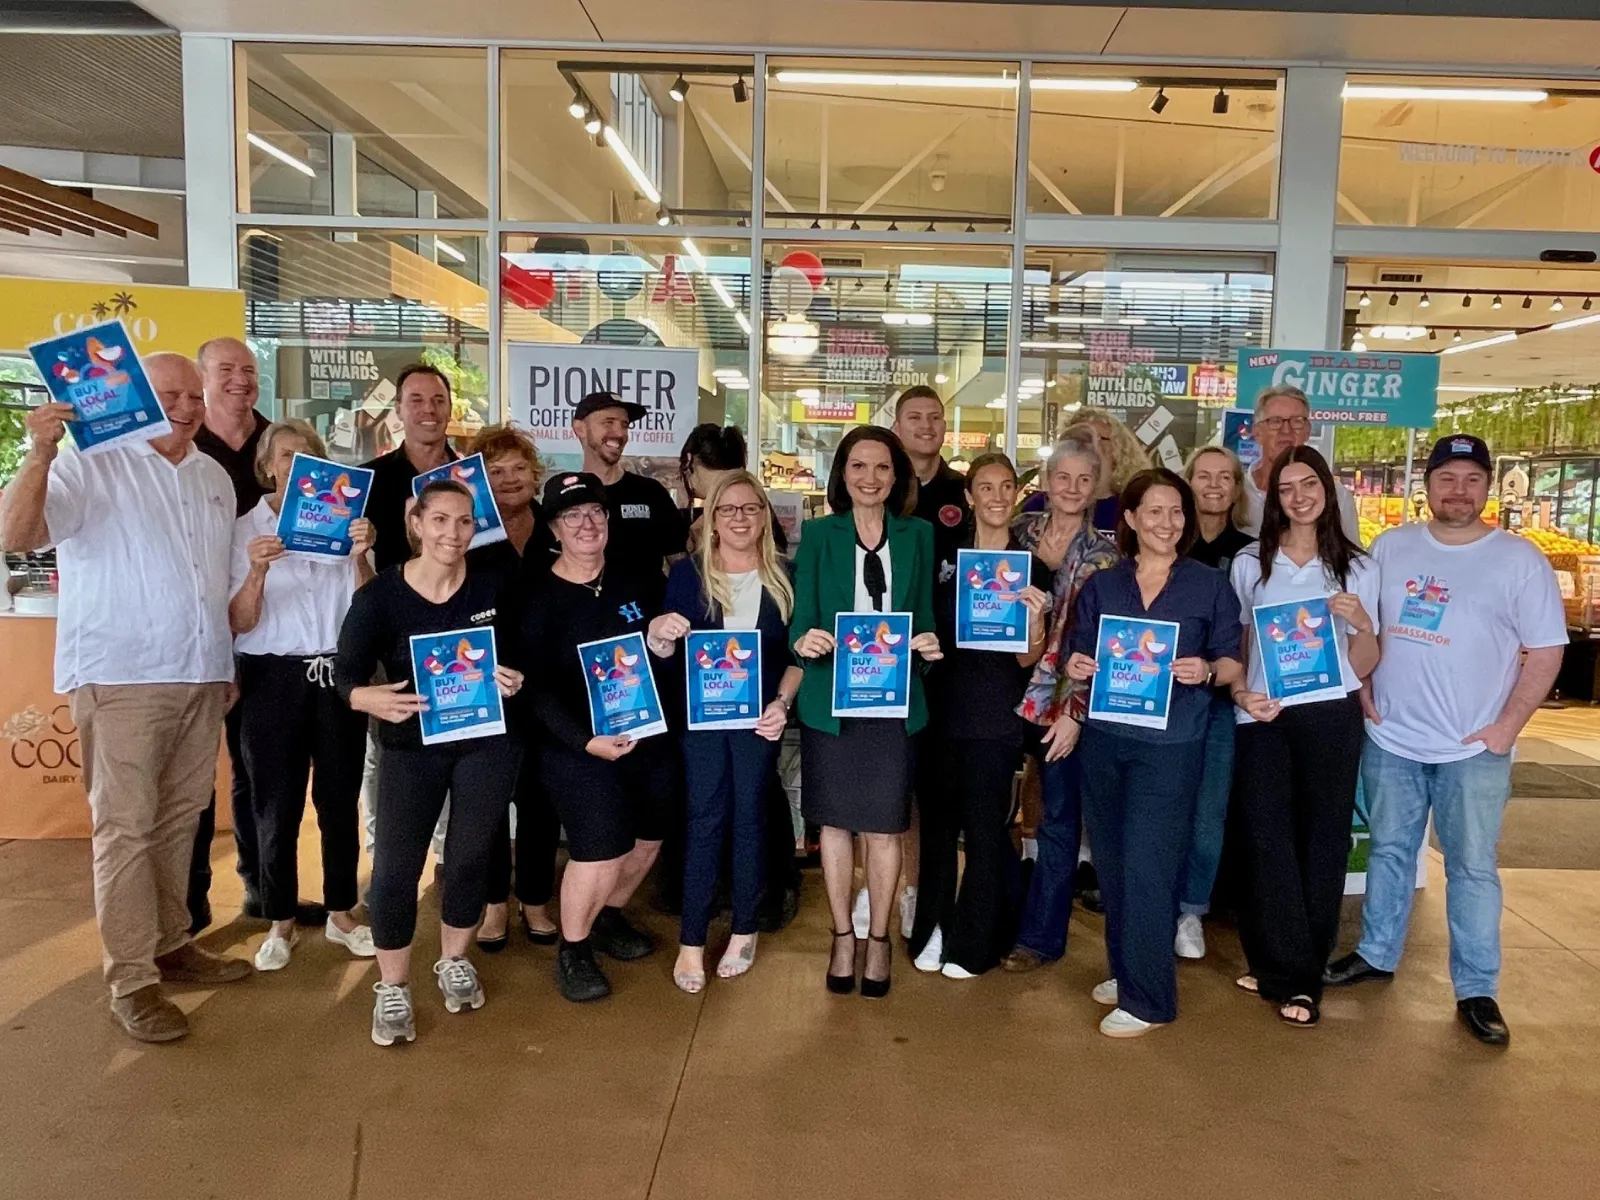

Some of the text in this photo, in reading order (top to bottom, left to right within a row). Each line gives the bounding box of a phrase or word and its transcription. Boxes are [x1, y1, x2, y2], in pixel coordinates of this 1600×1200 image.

[309, 349, 374, 365] WITH IGA
[1249, 354, 1278, 368] NEW
[1309, 356, 1402, 370] DIABLO
[826, 355, 914, 372] WITHOUT THE
[310, 364, 379, 380] REWARDS
[1088, 376, 1152, 392] WITH IGA
[1271, 360, 1403, 399] GINGER
[75, 383, 100, 397] BUY
[529, 366, 676, 410] PIONEER
[79, 389, 121, 407] LOCAL
[1087, 391, 1156, 408] REWARDS
[1337, 398, 1369, 407] BEER
[1308, 410, 1388, 422] LCOHOL FREE
[643, 431, 676, 443] COFFEE
[301, 501, 325, 511] BUY
[299, 511, 333, 524] LOCAL
[973, 593, 992, 601] BUY
[973, 602, 1002, 610] LOCAL
[1277, 643, 1298, 654] BUY
[851, 657, 873, 666] BUY
[1278, 651, 1312, 663] LOCAL
[851, 666, 883, 675] LOCAL
[1112, 662, 1134, 671] BUY
[435, 676, 456, 687] BUY
[1111, 671, 1143, 682] LOCAL
[436, 684, 470, 696] LOCAL
[602, 683, 617, 693] BUY
[704, 681, 735, 689] LOCAL
[43, 775, 77, 784] DAIRY
